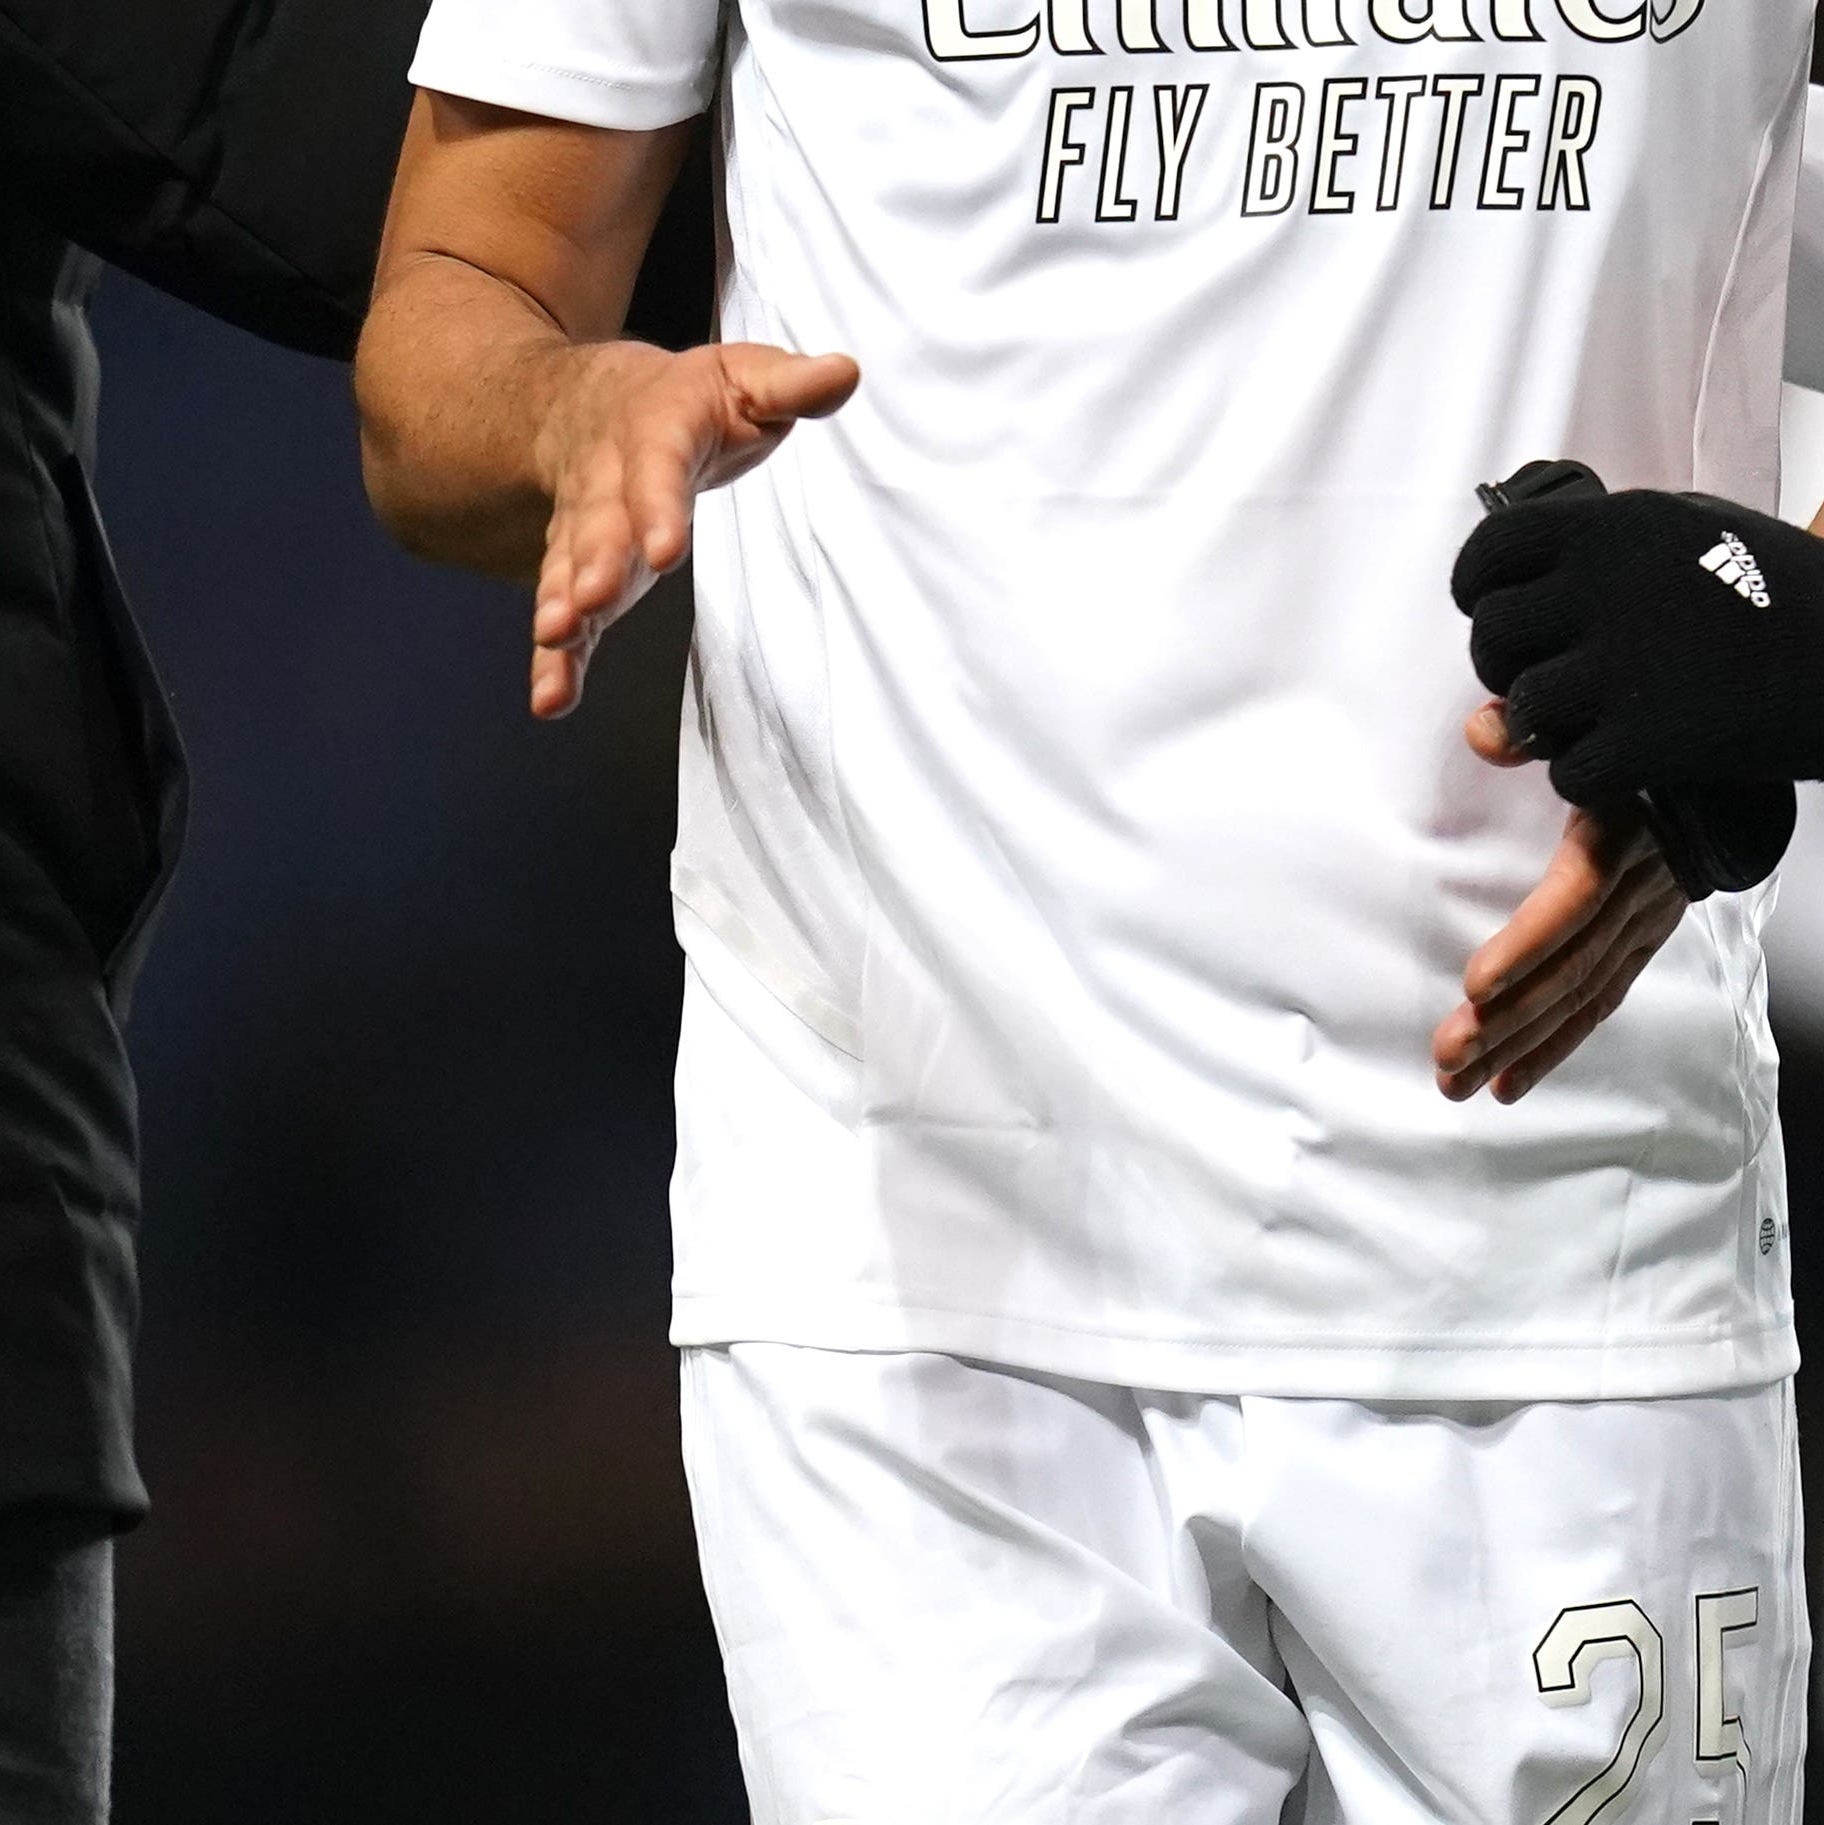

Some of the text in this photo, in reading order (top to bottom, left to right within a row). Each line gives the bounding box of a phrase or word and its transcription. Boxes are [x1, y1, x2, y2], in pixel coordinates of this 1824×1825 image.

[1036, 74, 1602, 224] FLY BETTER
[1721, 530, 1772, 608] adidas
[1532, 1586, 1759, 1825] 25
